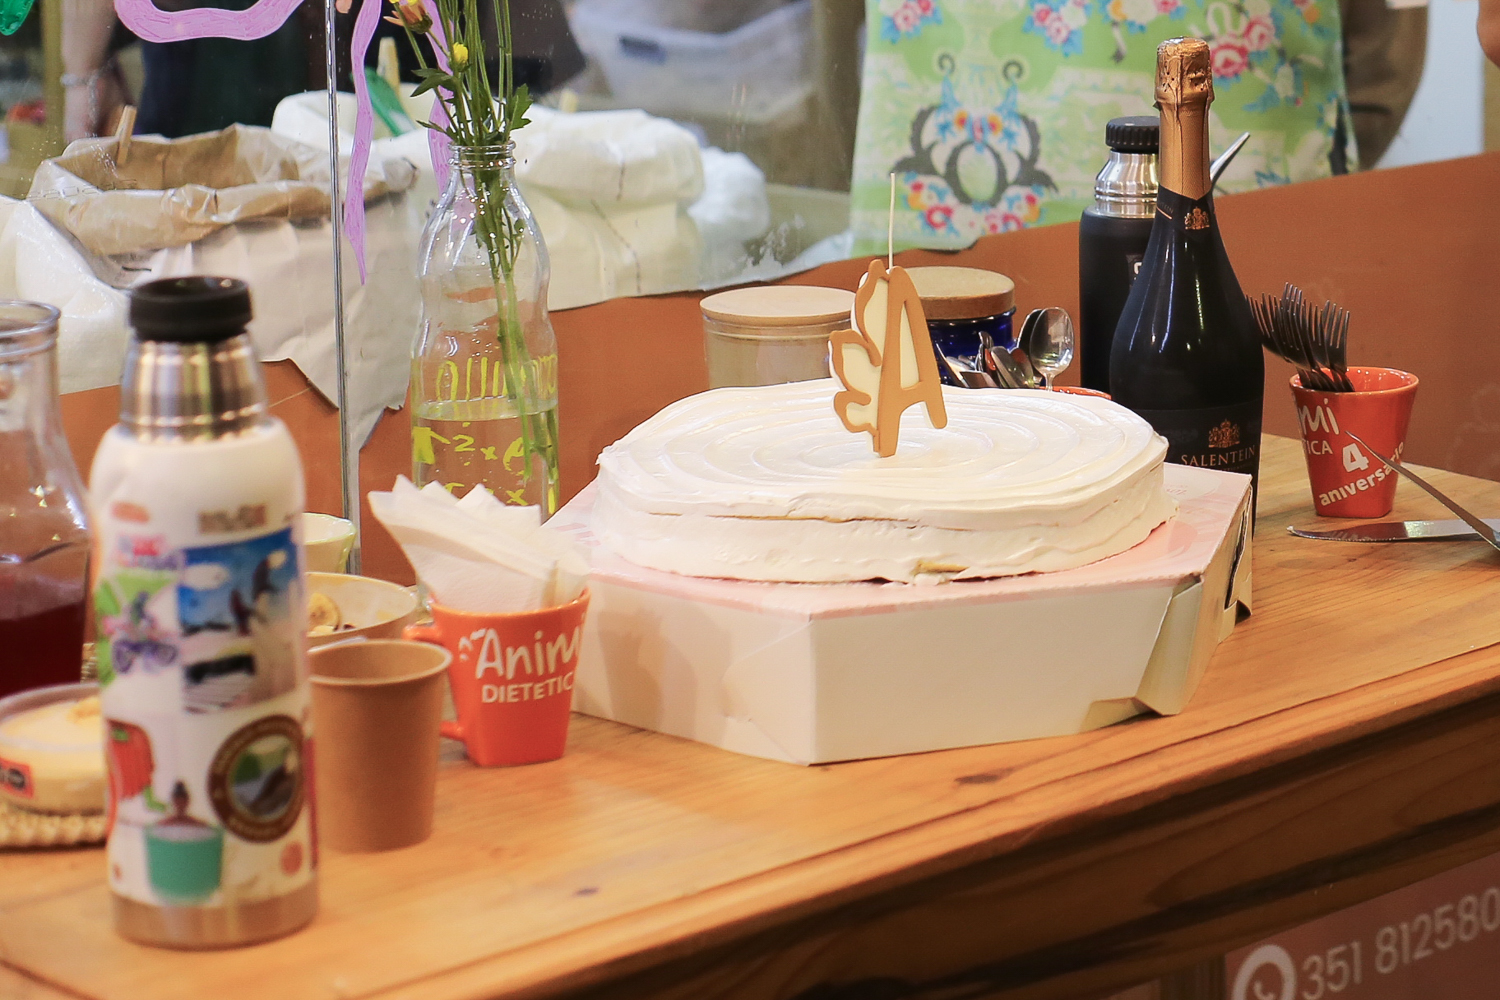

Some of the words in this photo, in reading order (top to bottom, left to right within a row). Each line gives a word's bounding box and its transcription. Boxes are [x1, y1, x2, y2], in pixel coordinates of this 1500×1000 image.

[1181, 445, 1256, 467] SALENTEIN
[1342, 443, 1369, 473] 4
[475, 612, 586, 680] Anim
[1301, 940, 1363, 1000] 351
